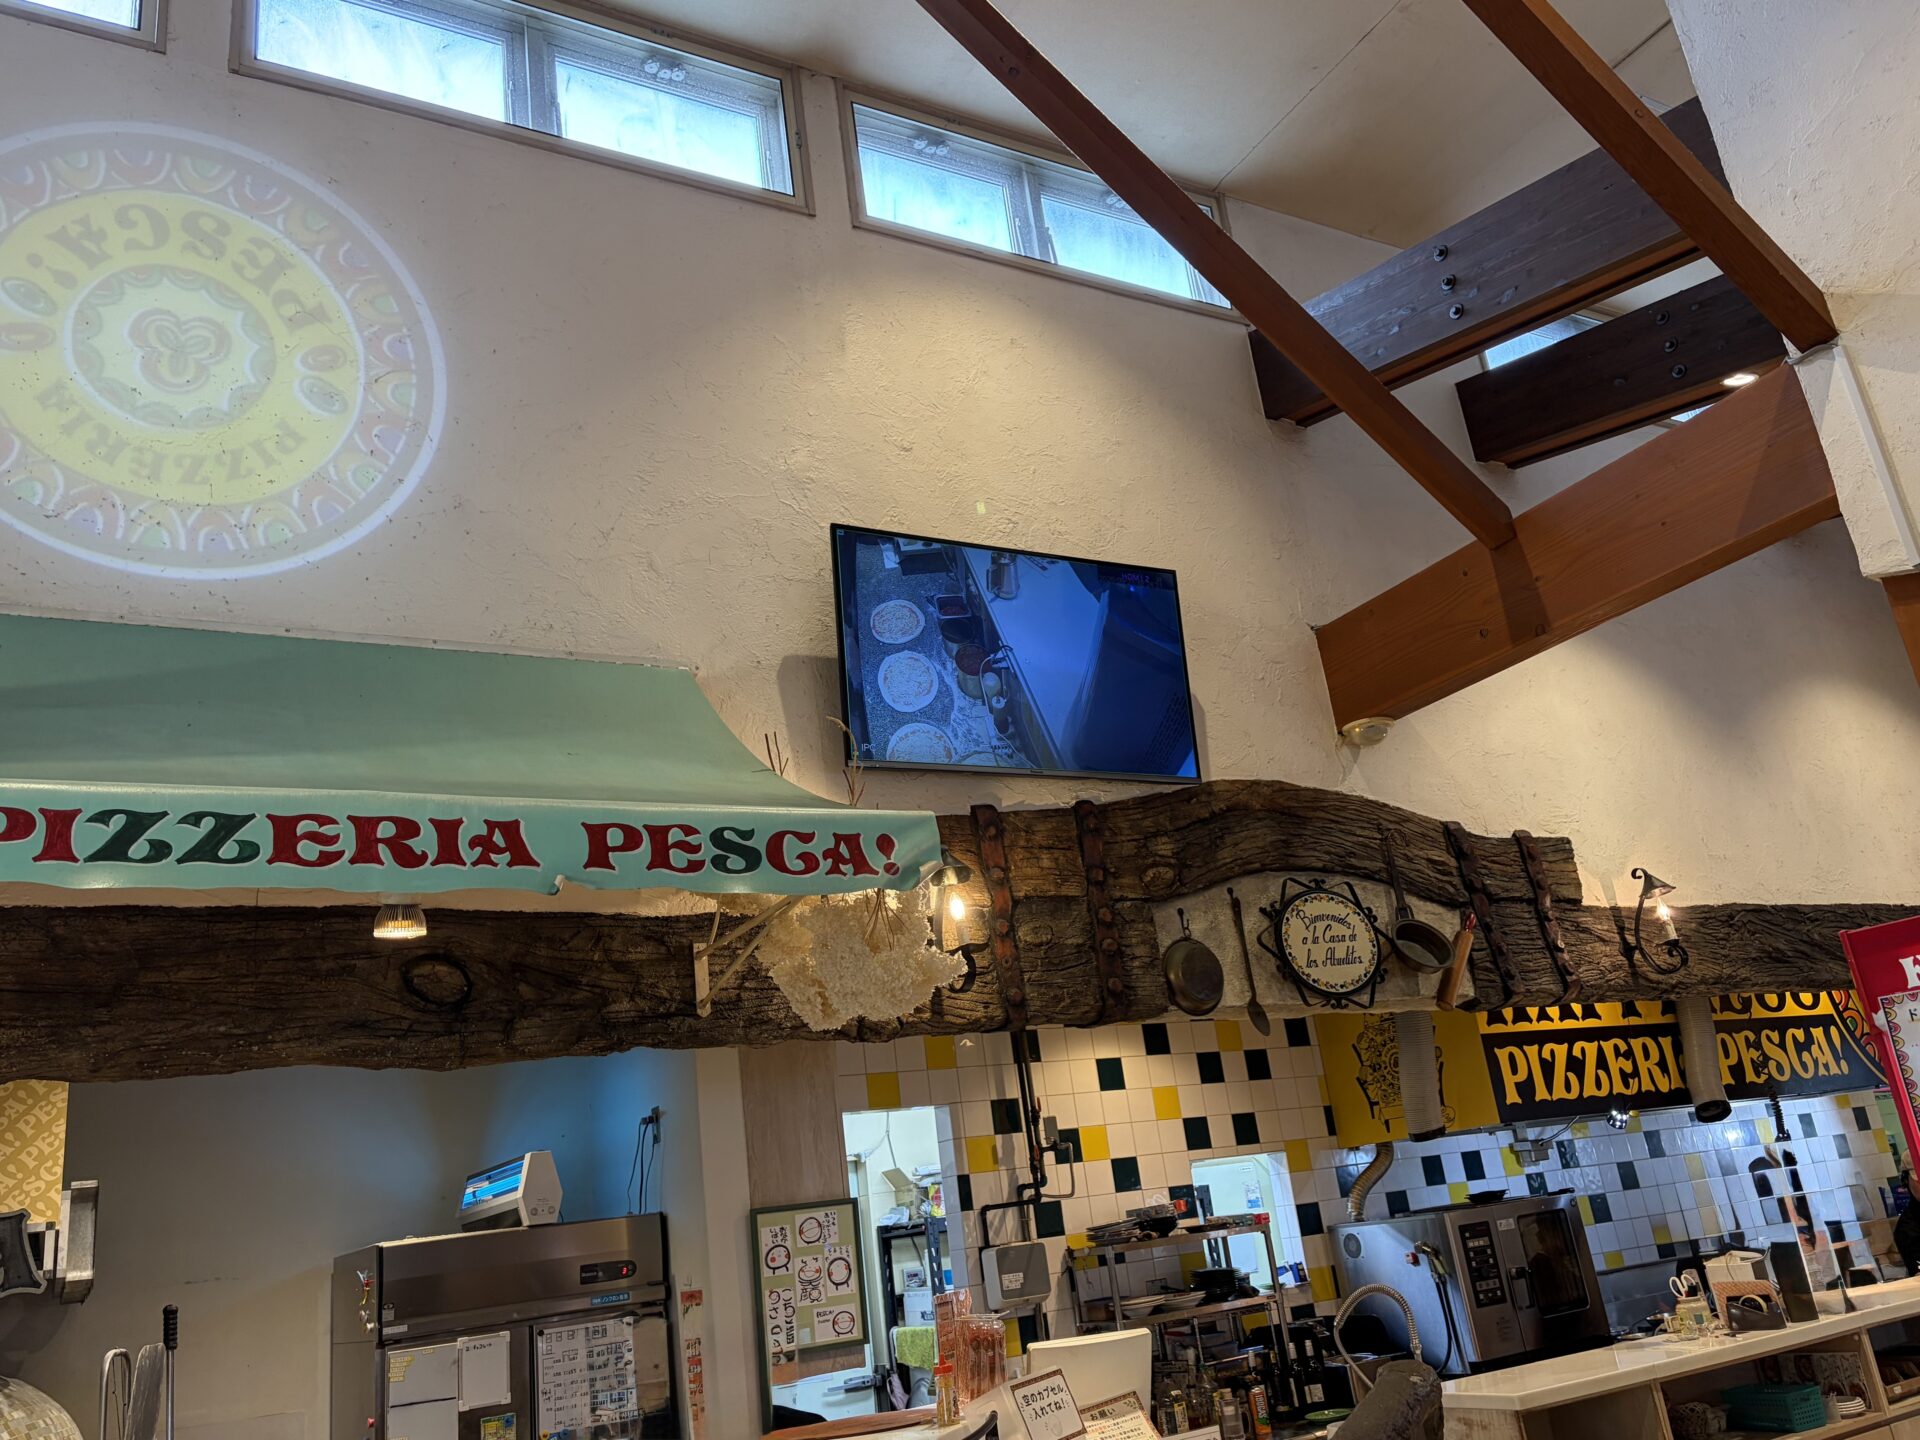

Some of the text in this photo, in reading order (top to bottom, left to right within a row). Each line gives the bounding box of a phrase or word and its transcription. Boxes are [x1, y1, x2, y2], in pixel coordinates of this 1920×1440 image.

[36, 378, 306, 487] PIZZERIA
[0, 806, 900, 876] PIZZERIA PESCA!
[1311, 925, 1319, 945] la
[1322, 924, 1346, 944] Casa
[1349, 925, 1357, 942] de
[1305, 946, 1364, 969] los Abuelitos
[1493, 1023, 1850, 1107] PIZZERI PESCA!
[1022, 1383, 1064, 1407] 空のカプセル
[1089, 1407, 1116, 1421] お願い
